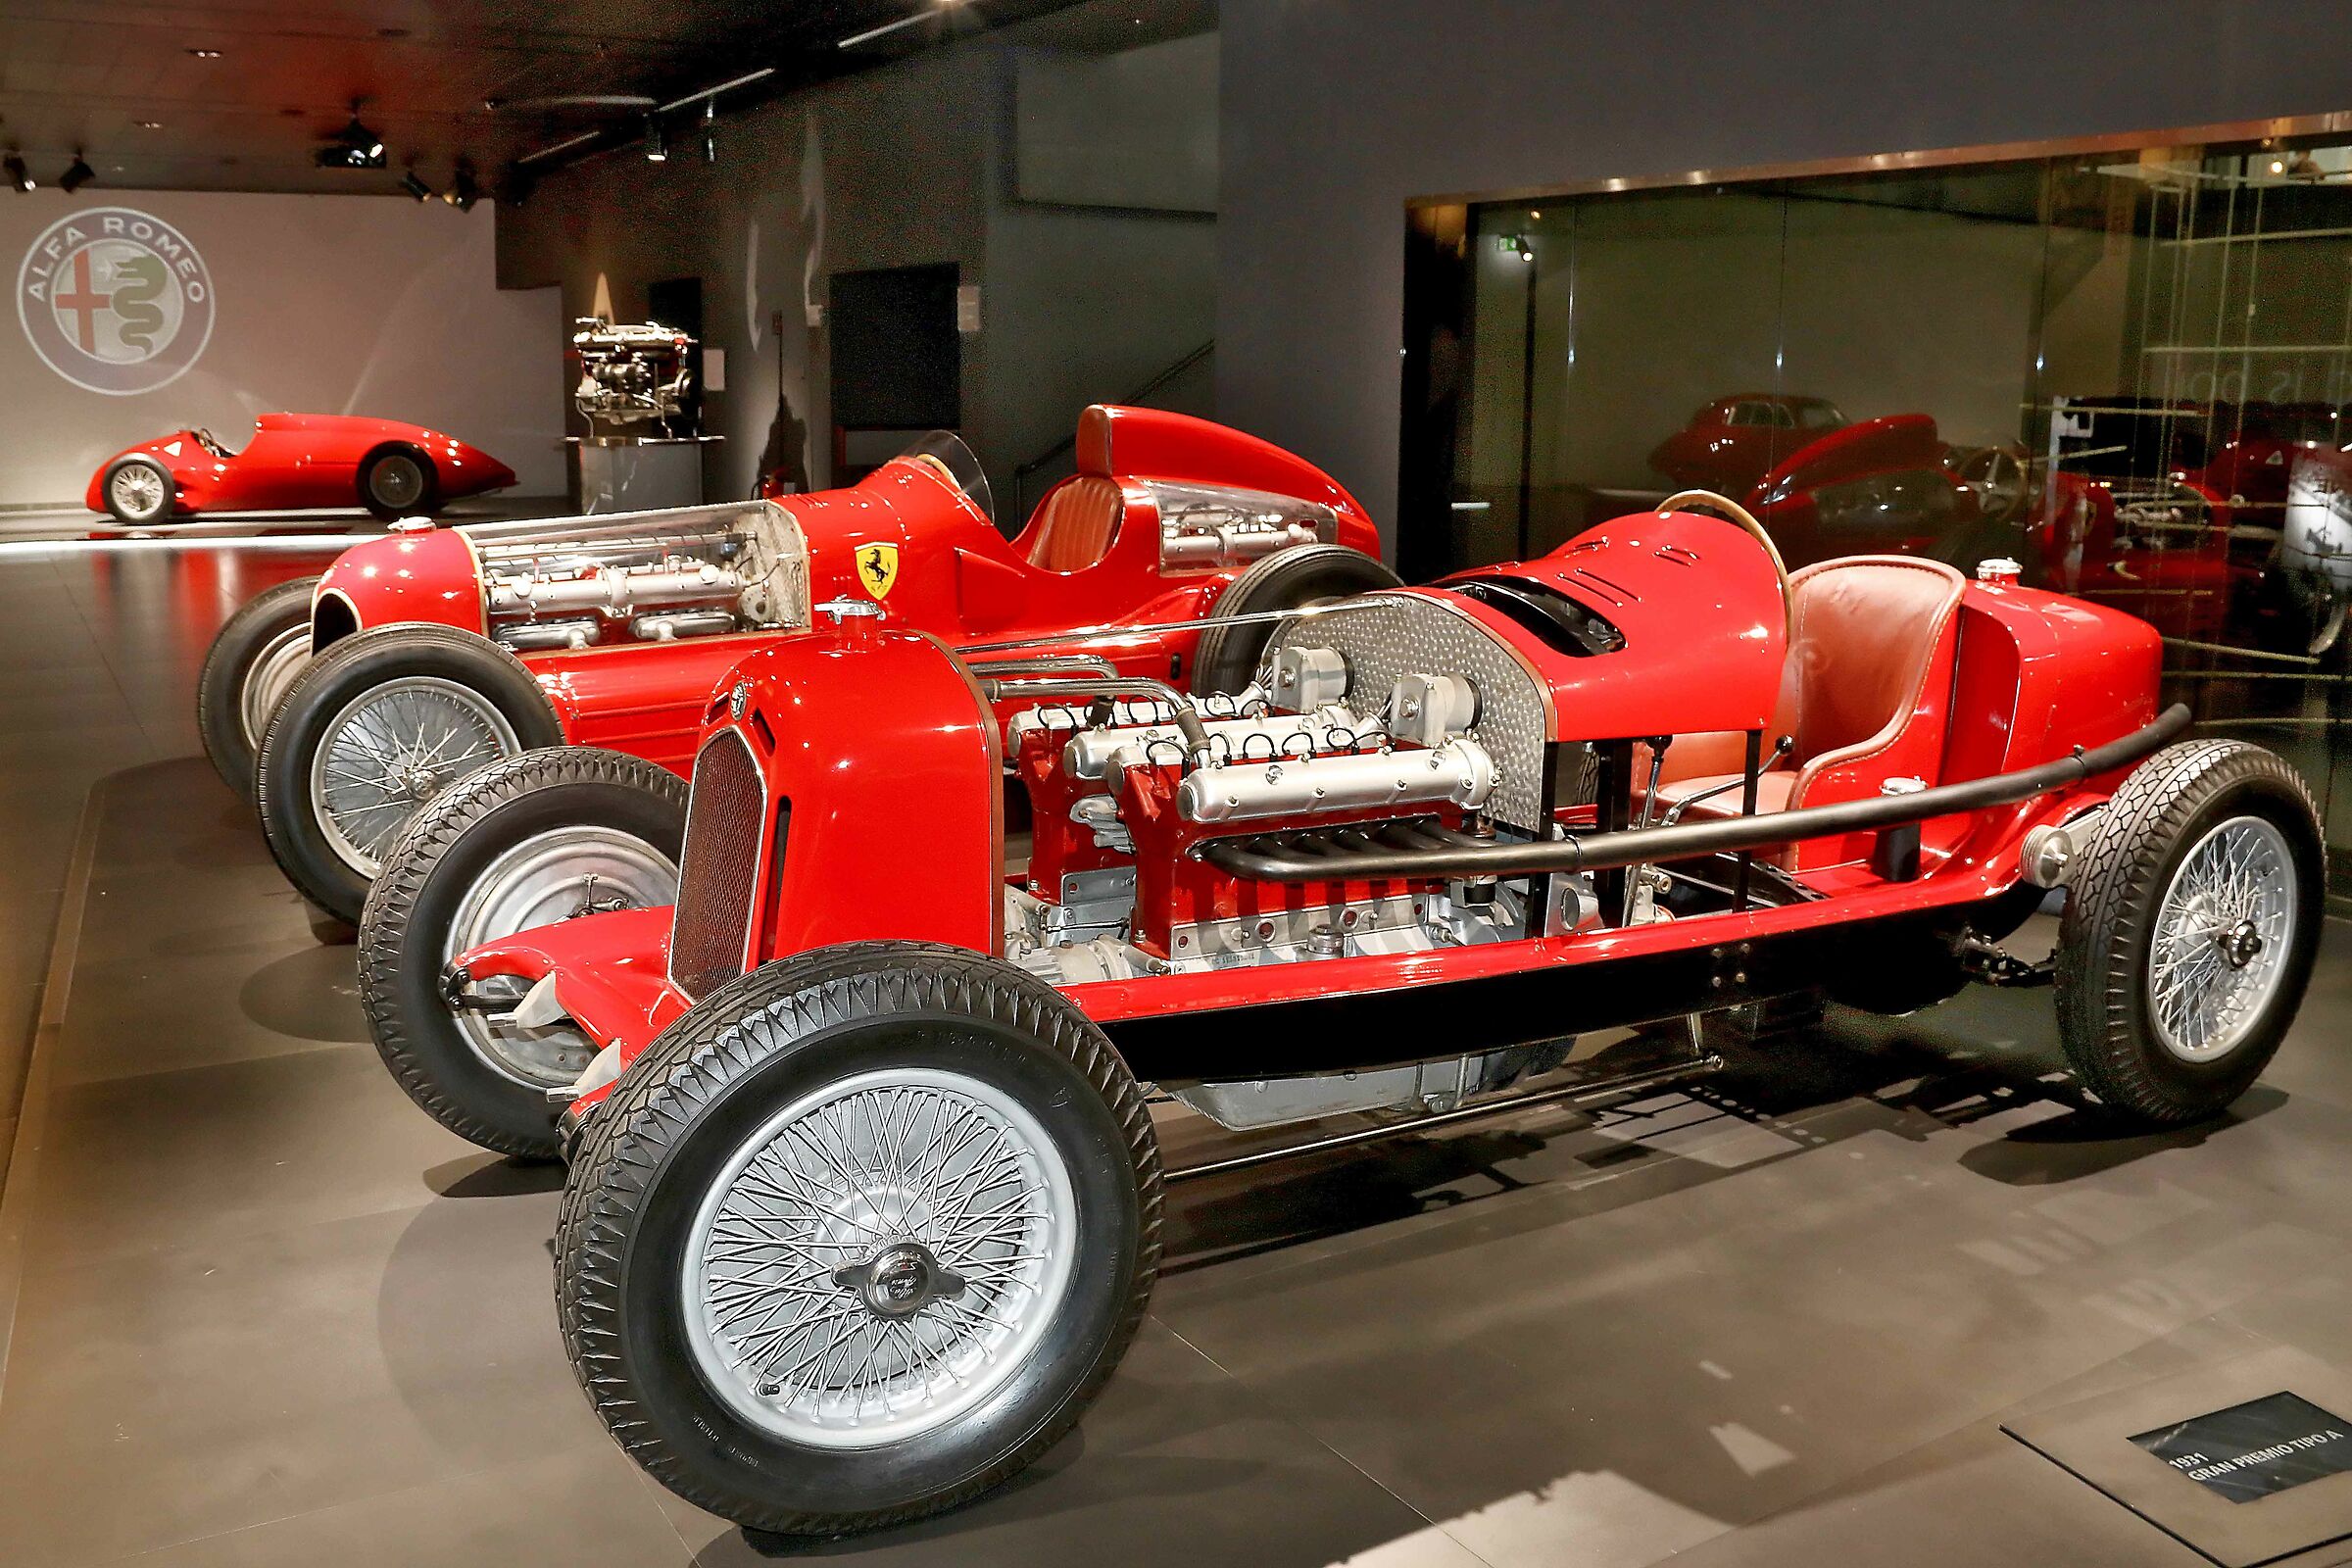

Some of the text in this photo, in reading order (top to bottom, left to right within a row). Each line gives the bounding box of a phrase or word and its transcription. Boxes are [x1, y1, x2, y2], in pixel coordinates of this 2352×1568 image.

[27, 217, 205, 304] ALFA ROMEO
[2169, 1451, 2210, 1470] 1931
[2187, 1429, 2344, 1482] GRAN PREMIO TIPO A
